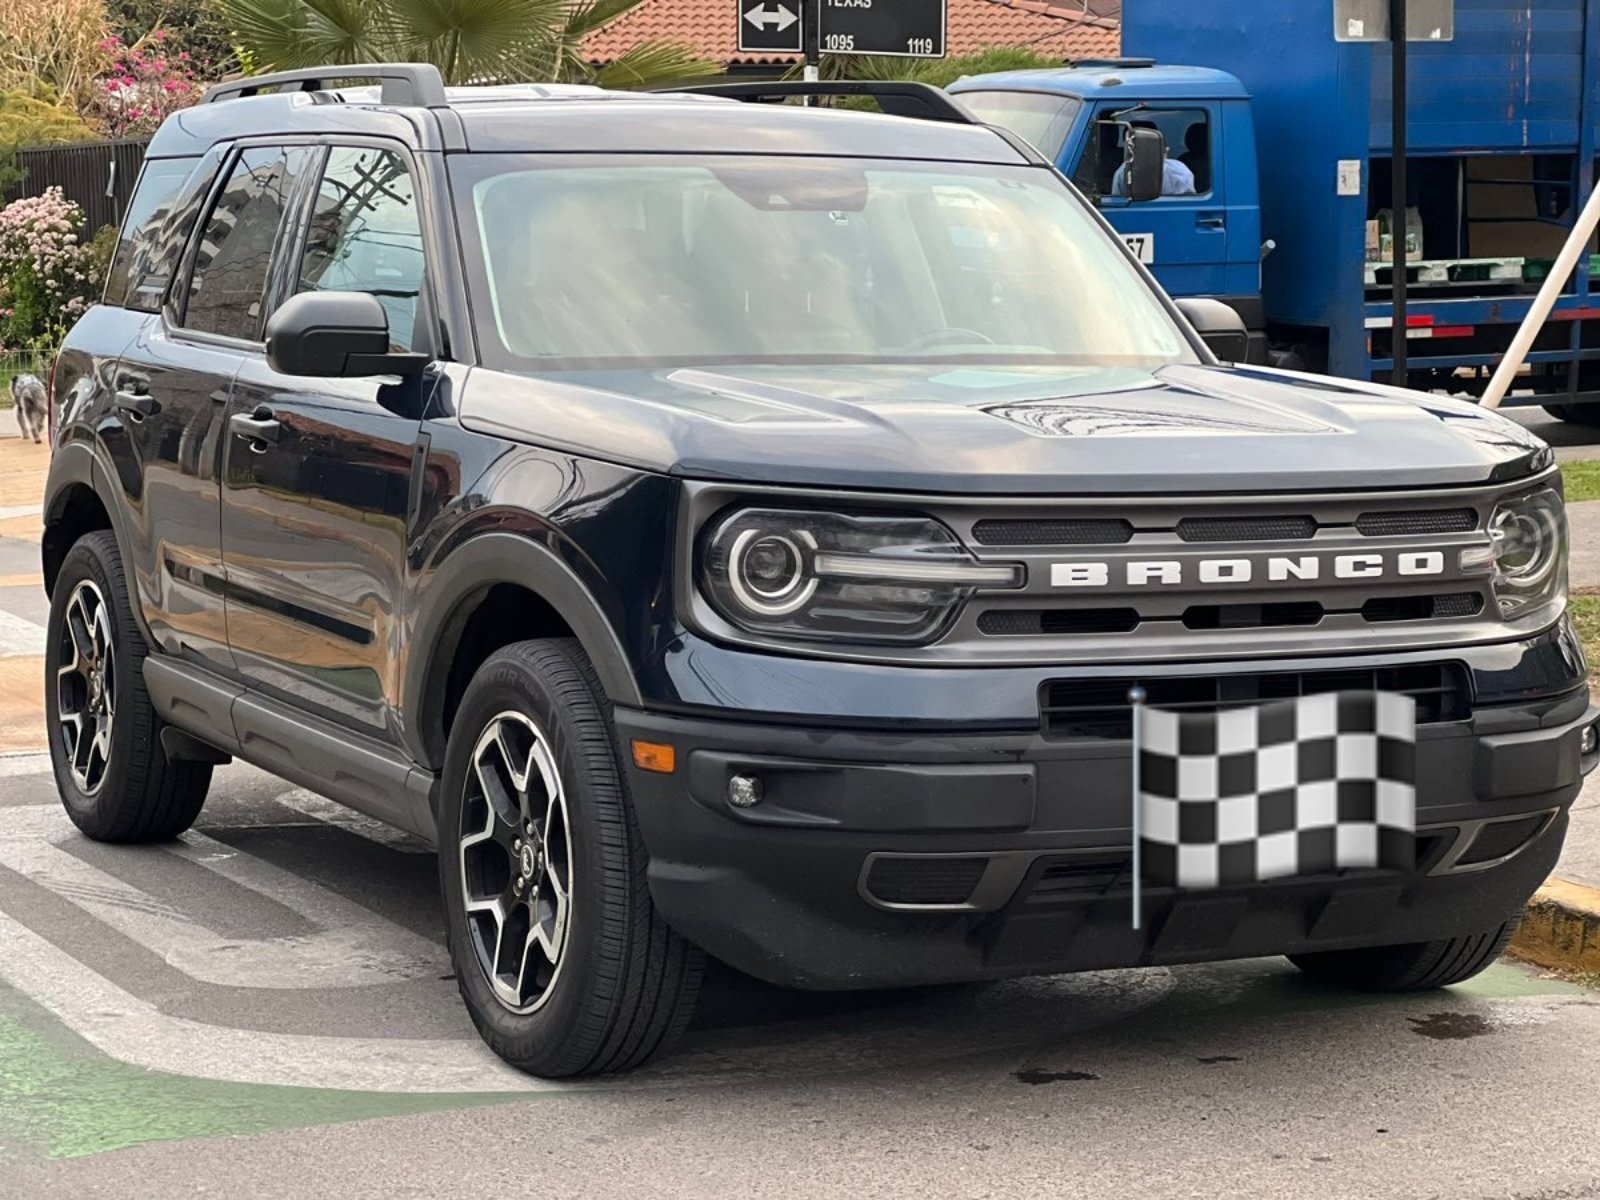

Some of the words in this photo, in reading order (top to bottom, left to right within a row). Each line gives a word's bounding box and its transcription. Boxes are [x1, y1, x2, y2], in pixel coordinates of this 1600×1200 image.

[825, 34, 854, 50] 1095
[907, 38, 933, 53] 1119
[1050, 551, 1444, 587] BRONCO
